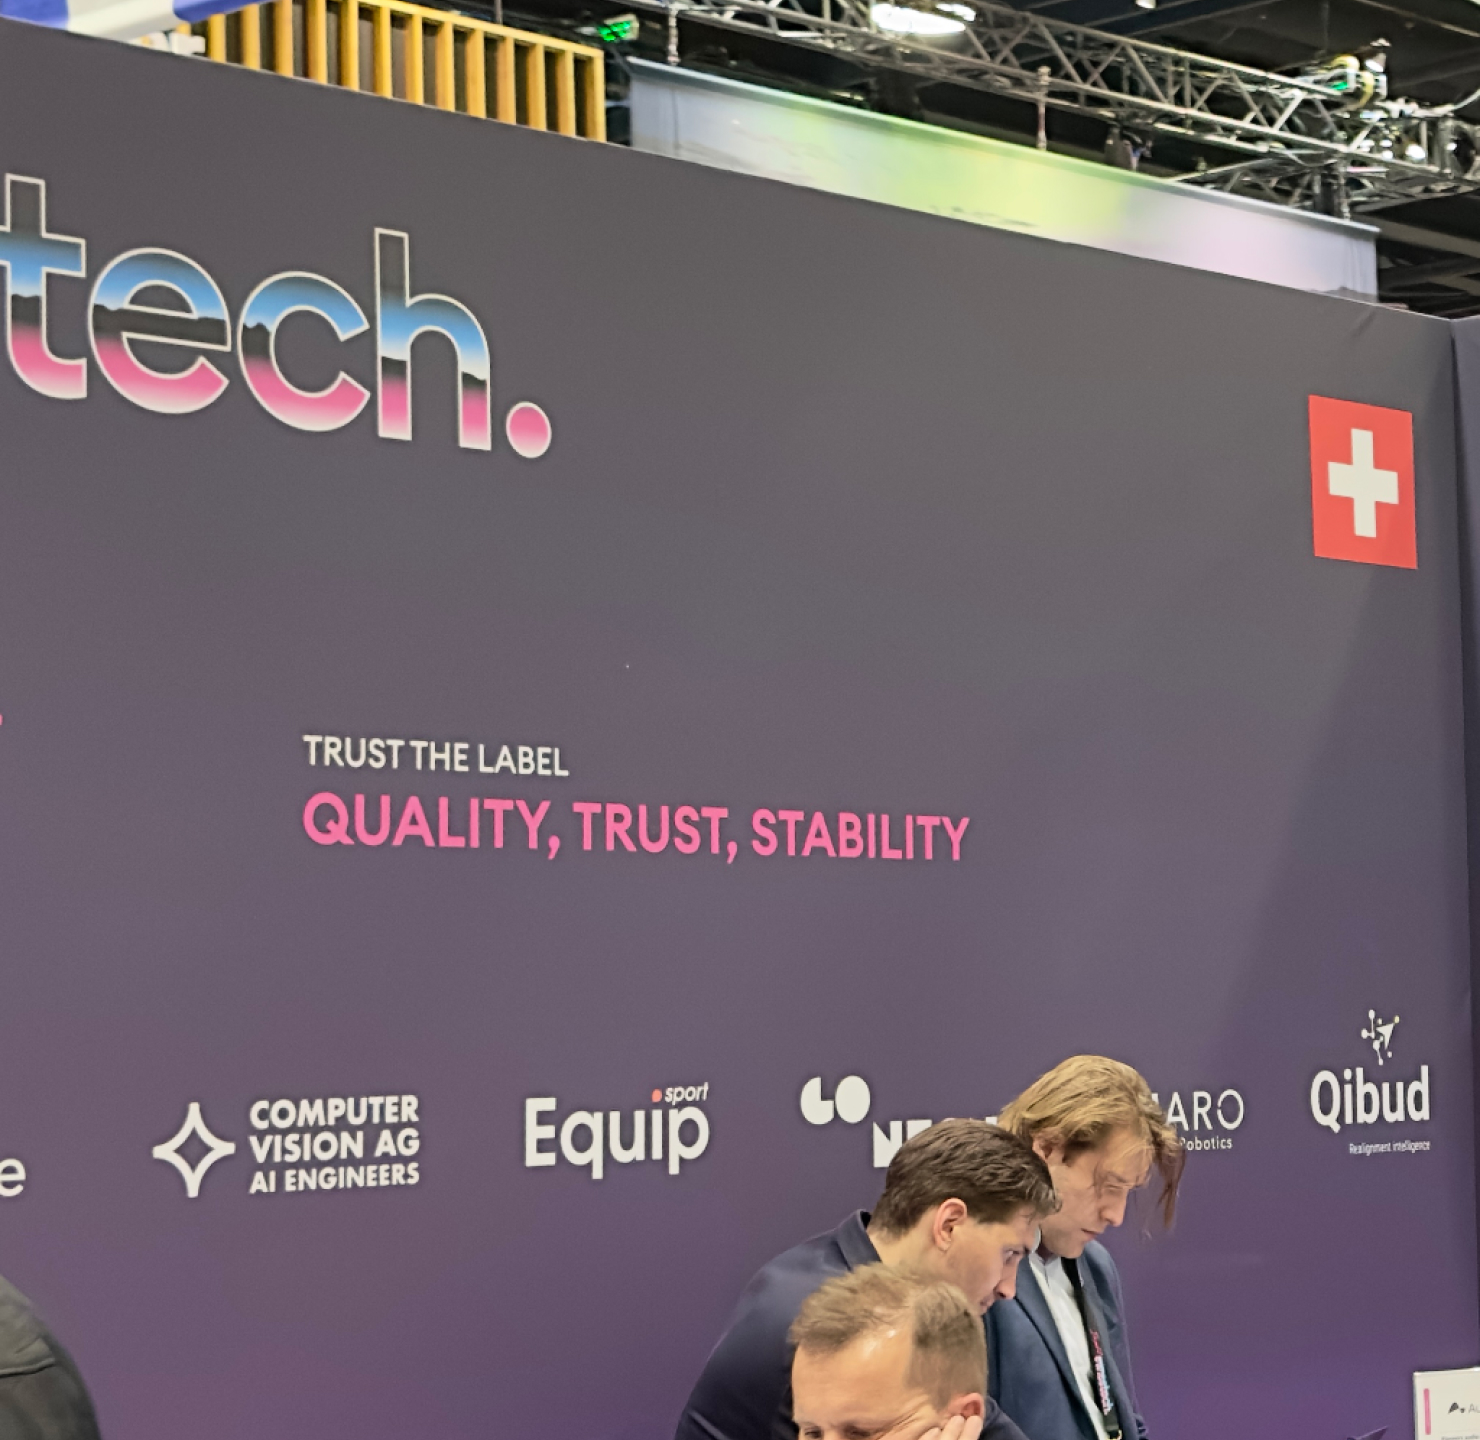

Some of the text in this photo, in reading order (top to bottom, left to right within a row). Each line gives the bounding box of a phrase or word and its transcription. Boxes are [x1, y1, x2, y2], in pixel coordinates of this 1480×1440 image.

[303, 734, 569, 777] TRUST THE LABEL
[302, 791, 971, 864] QUALITY, TRUST, STABILITY
[249, 1095, 419, 1130] COMPUTER
[664, 1082, 709, 1105] sport
[1310, 1065, 1430, 1133] Qibud
[249, 1128, 420, 1163] VISION AG
[525, 1090, 710, 1180] Equip
[249, 1162, 420, 1194] AI ENGINEERS
